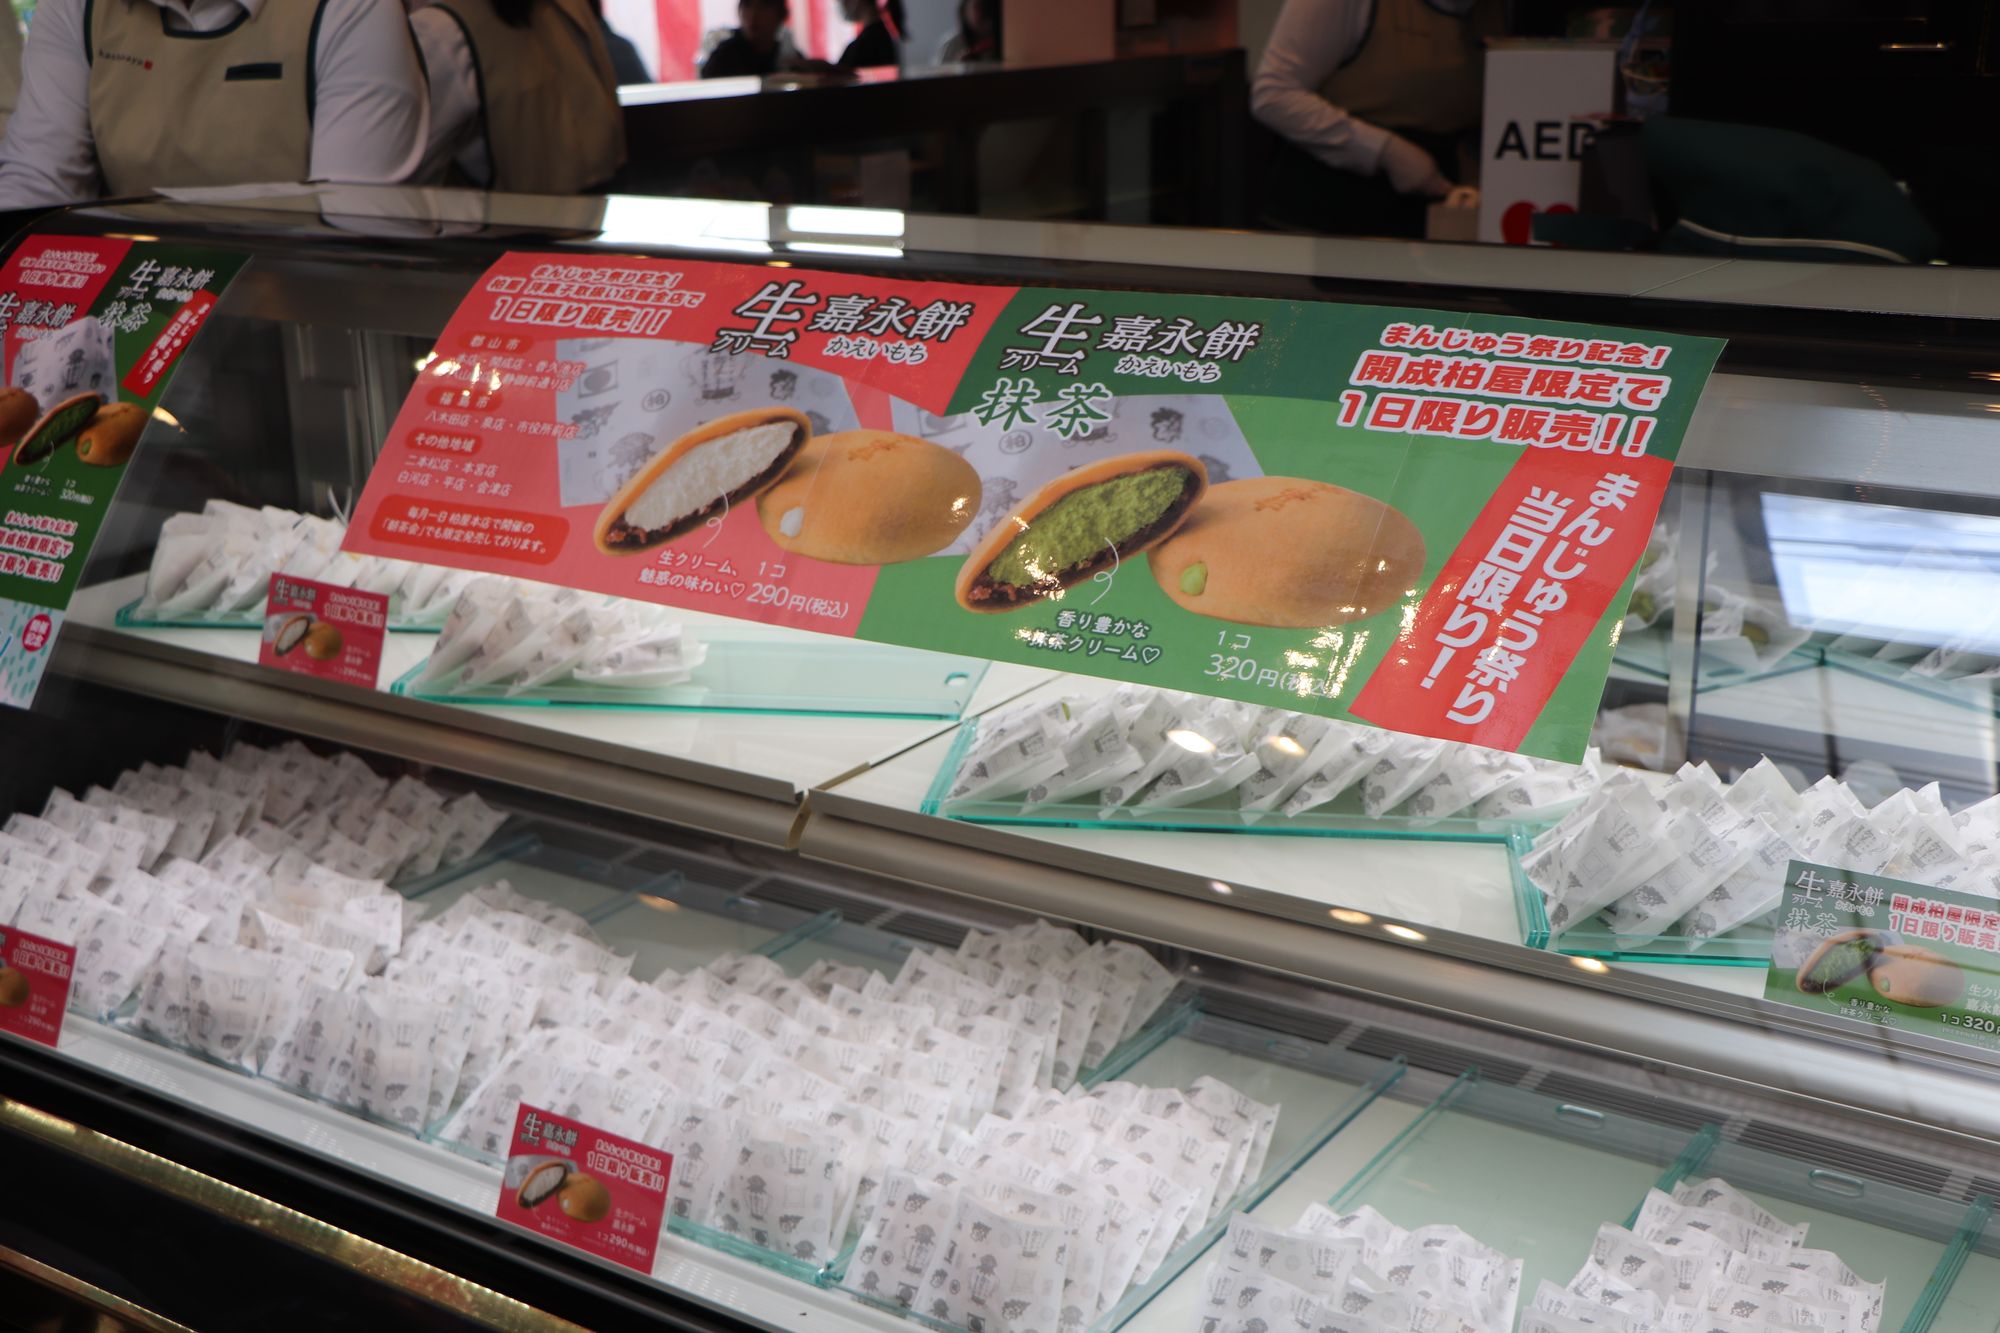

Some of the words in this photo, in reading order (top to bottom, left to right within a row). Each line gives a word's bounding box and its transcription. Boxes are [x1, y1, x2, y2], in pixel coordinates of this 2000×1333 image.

[718, 280, 818, 343] 生
[806, 295, 976, 342] 嘉永餅
[711, 333, 791, 359] クリーム
[824, 336, 928, 364] かえいもち
[1004, 302, 1103, 361] 生
[1096, 314, 1262, 361] 嘉永餅
[1380, 322, 1672, 370] まんじゅう祭り記念!
[999, 352, 1080, 376] クリーム
[1114, 354, 1221, 383] かえいもち
[1349, 349, 1672, 412] 開成柏屋限定で
[971, 377, 1112, 440] 抹茶
[1336, 389, 1657, 457] 1日限り販売!!
[414, 432, 477, 452] その他地域
[657, 549, 738, 576] 生クリーム、
[758, 561, 787, 579] 1コ
[746, 582, 850, 619] 290円(税込)
[1419, 485, 1575, 690] 当日限り!
[1445, 472, 1641, 725] まんじゅう祭り
[1056, 609, 1152, 639] 香り豊かな
[1217, 630, 1251, 650] 1コ
[1794, 869, 1825, 902] 生
[1826, 878, 1885, 907] 嘉永餅
[1785, 907, 1841, 937] 抹茶
[1888, 914, 2000, 952] 1日限り販売
